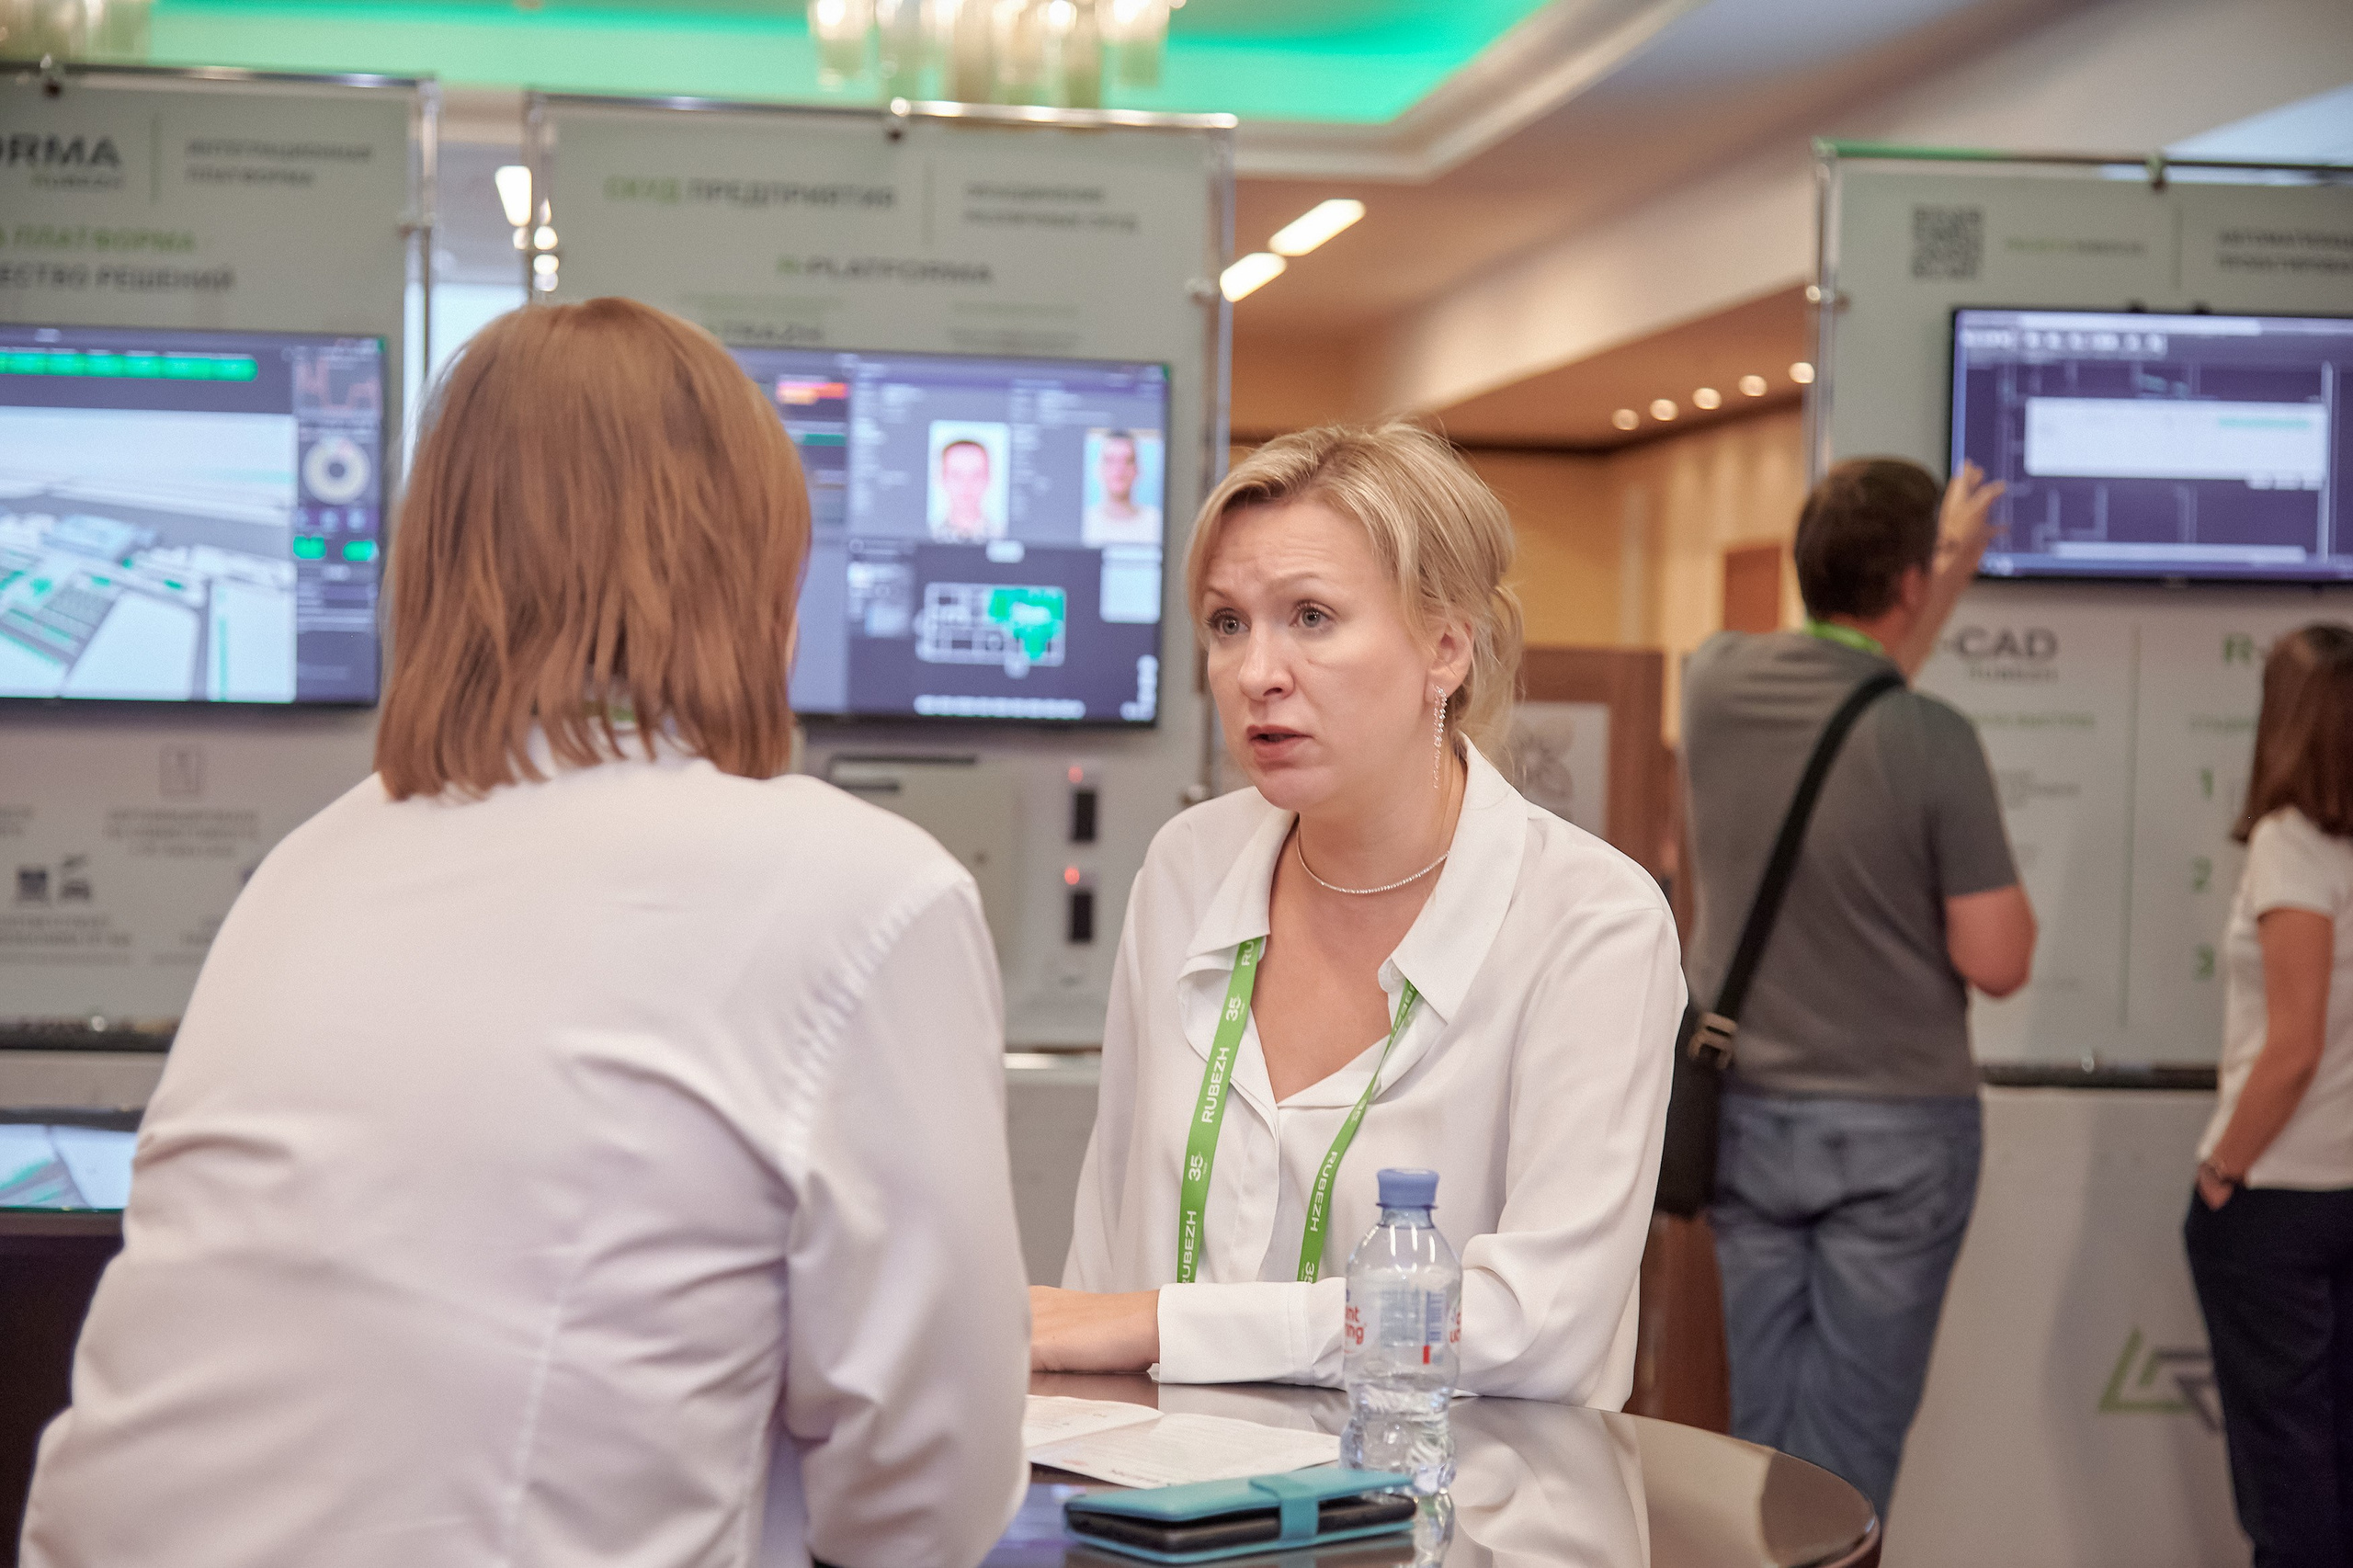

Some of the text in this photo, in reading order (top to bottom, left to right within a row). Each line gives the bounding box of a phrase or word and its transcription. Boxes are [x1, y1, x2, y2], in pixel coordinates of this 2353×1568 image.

[14, 224, 197, 253] ПЛАТФОРМА
[0, 261, 236, 293] ЕСТВО РЕШЕНИЙ
[1241, 940, 1255, 966] RU
[1225, 994, 1241, 1021] 35
[1201, 1046, 1230, 1123] RUBEZH
[1188, 1153, 1203, 1182] 35
[1310, 1151, 1338, 1233] RUBEZH
